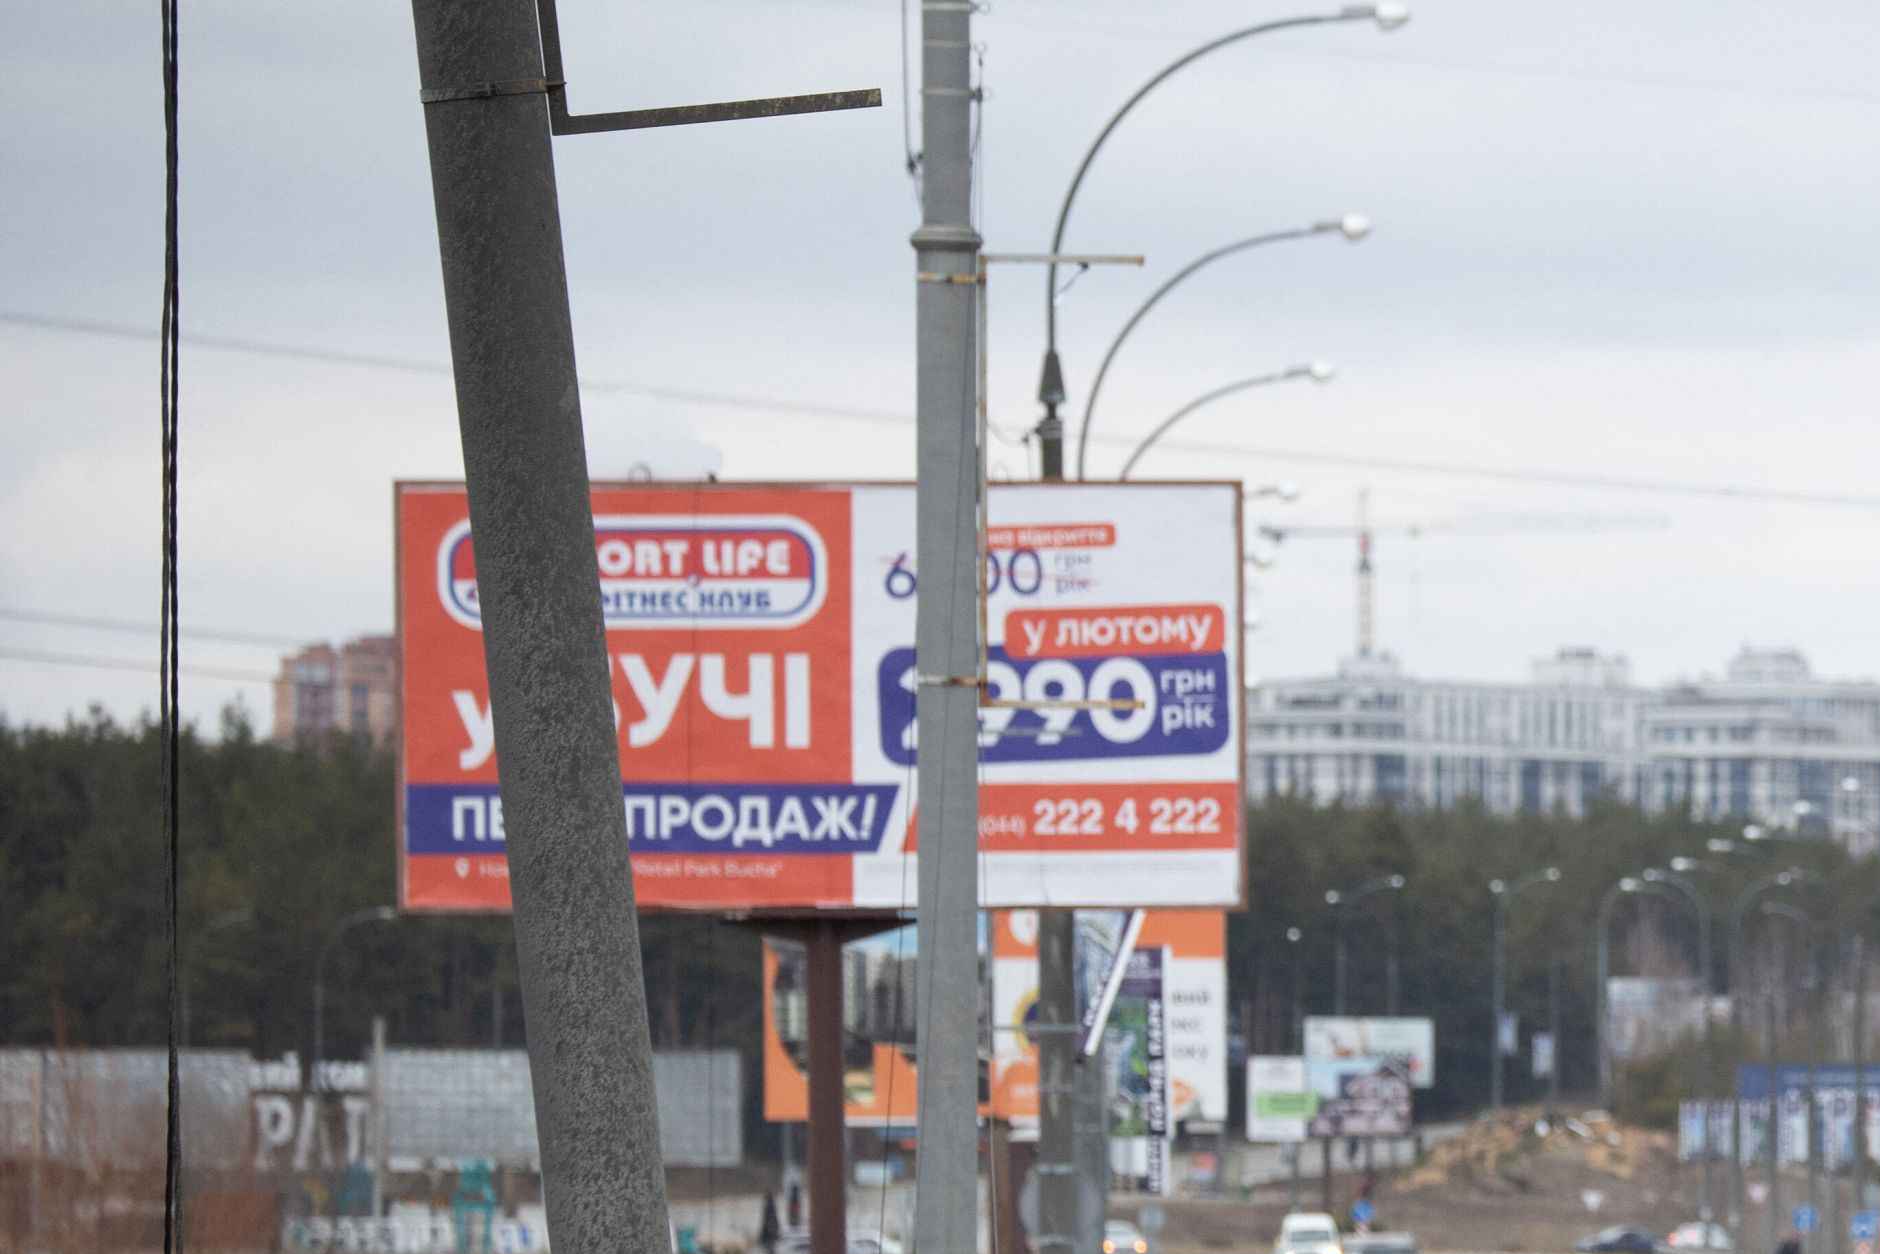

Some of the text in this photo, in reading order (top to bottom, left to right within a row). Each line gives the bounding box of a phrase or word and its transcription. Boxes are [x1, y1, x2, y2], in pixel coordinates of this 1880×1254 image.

[598, 539, 790, 576] ORT LIFE
[1023, 613, 1214, 655] у лютому
[609, 653, 810, 749] УЧІ
[1160, 668, 1215, 699] грн
[1161, 701, 1216, 736] рік
[1033, 797, 1104, 836] 222
[1114, 797, 1137, 835] 4
[1149, 796, 1221, 835] 222
